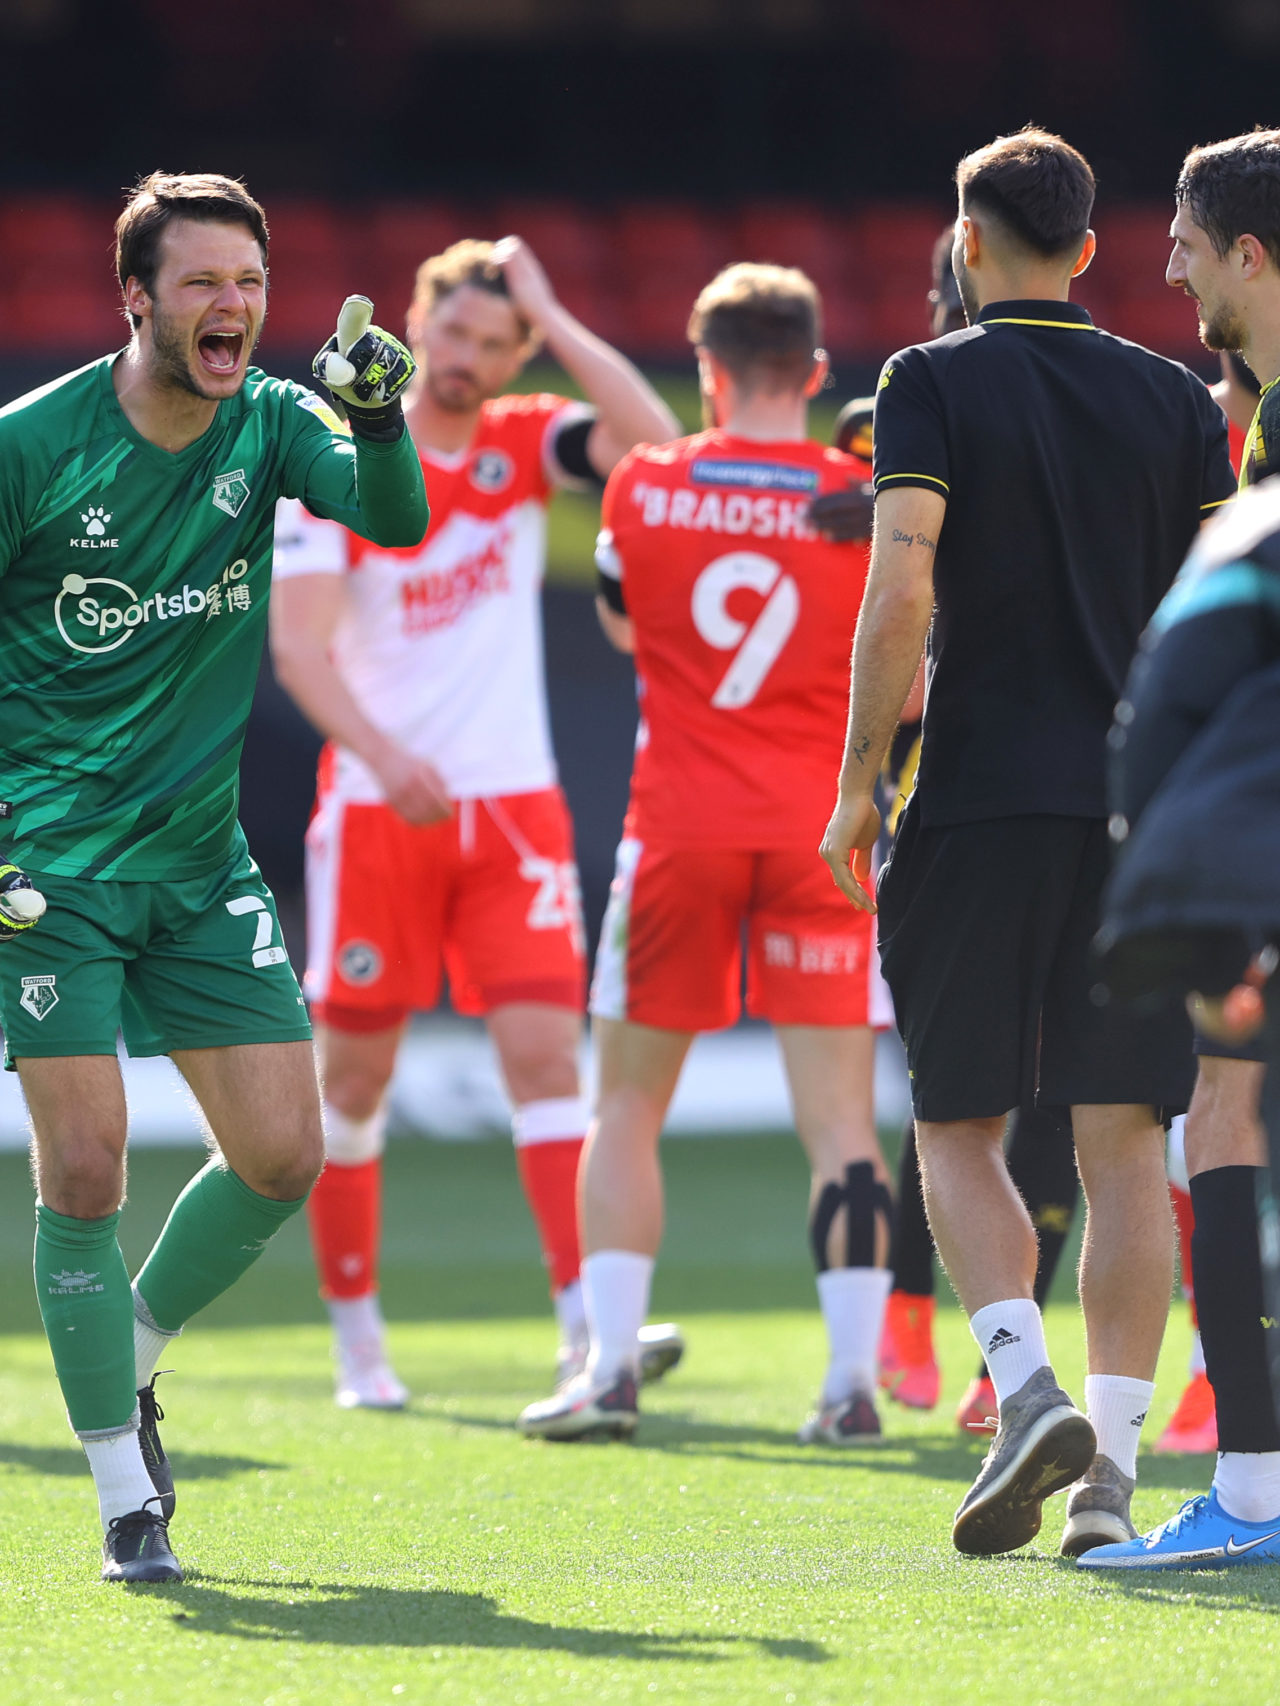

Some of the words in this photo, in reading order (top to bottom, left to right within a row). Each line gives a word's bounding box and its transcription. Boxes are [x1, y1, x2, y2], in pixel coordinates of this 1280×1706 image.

[642, 489, 819, 541] BRADSH
[70, 538, 119, 549] KELME
[892, 529, 914, 547] Stay
[690, 551, 800, 710] 9
[48, 1284, 105, 1295] KELME
[988, 1335, 1021, 1354] adidas
[1180, 1551, 1217, 1560] PHANTOM
